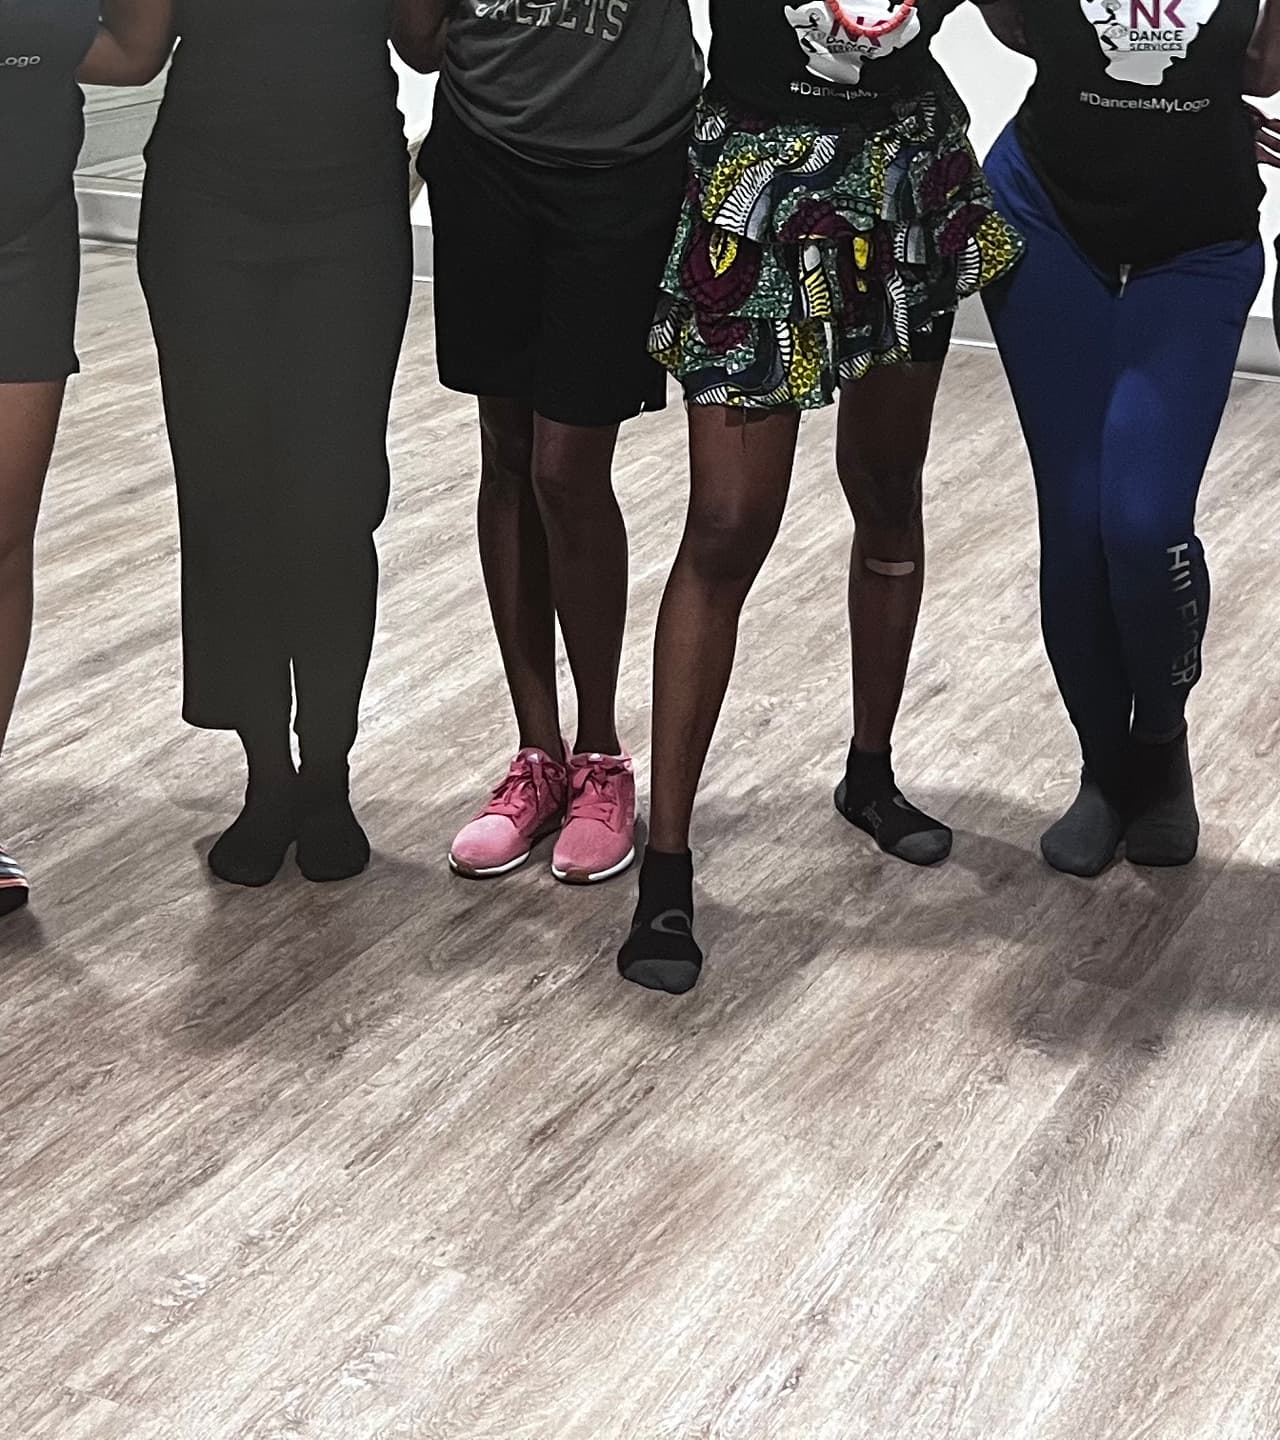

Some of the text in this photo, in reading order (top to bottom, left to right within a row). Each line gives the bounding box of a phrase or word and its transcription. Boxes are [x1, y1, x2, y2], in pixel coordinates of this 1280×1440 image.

[1129, 30, 1183, 42] DANCE
[1129, 43, 1183, 51] SERVICES
[1079, 90, 1210, 113] #DanceIsMyLogo
